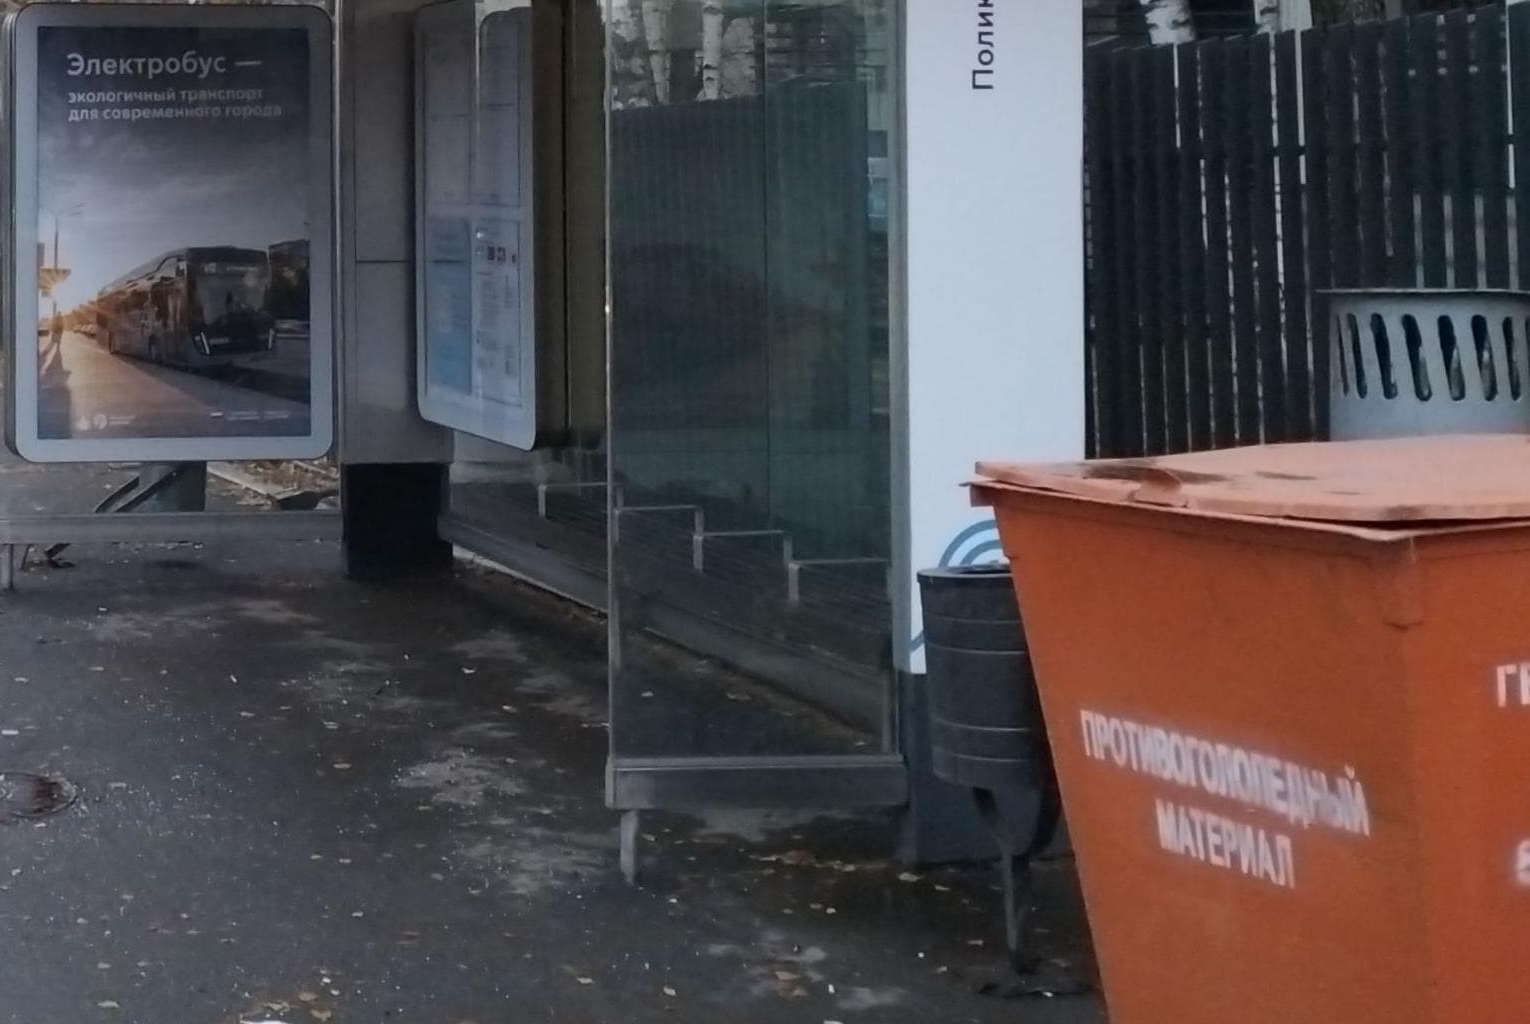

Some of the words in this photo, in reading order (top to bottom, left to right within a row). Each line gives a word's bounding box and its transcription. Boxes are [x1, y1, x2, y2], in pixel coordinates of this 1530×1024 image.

[66, 51, 227, 79] Электробус
[68, 88, 176, 104] экологичный
[181, 88, 264, 104] транспорт
[68, 105, 99, 122] для
[102, 104, 222, 121] современного
[225, 102, 283, 119] города
[1079, 708, 1370, 836] ПРОТИВОГОЛОЛЕДНЫЙ
[1156, 799, 1296, 888] МАТЕРИАЛ
